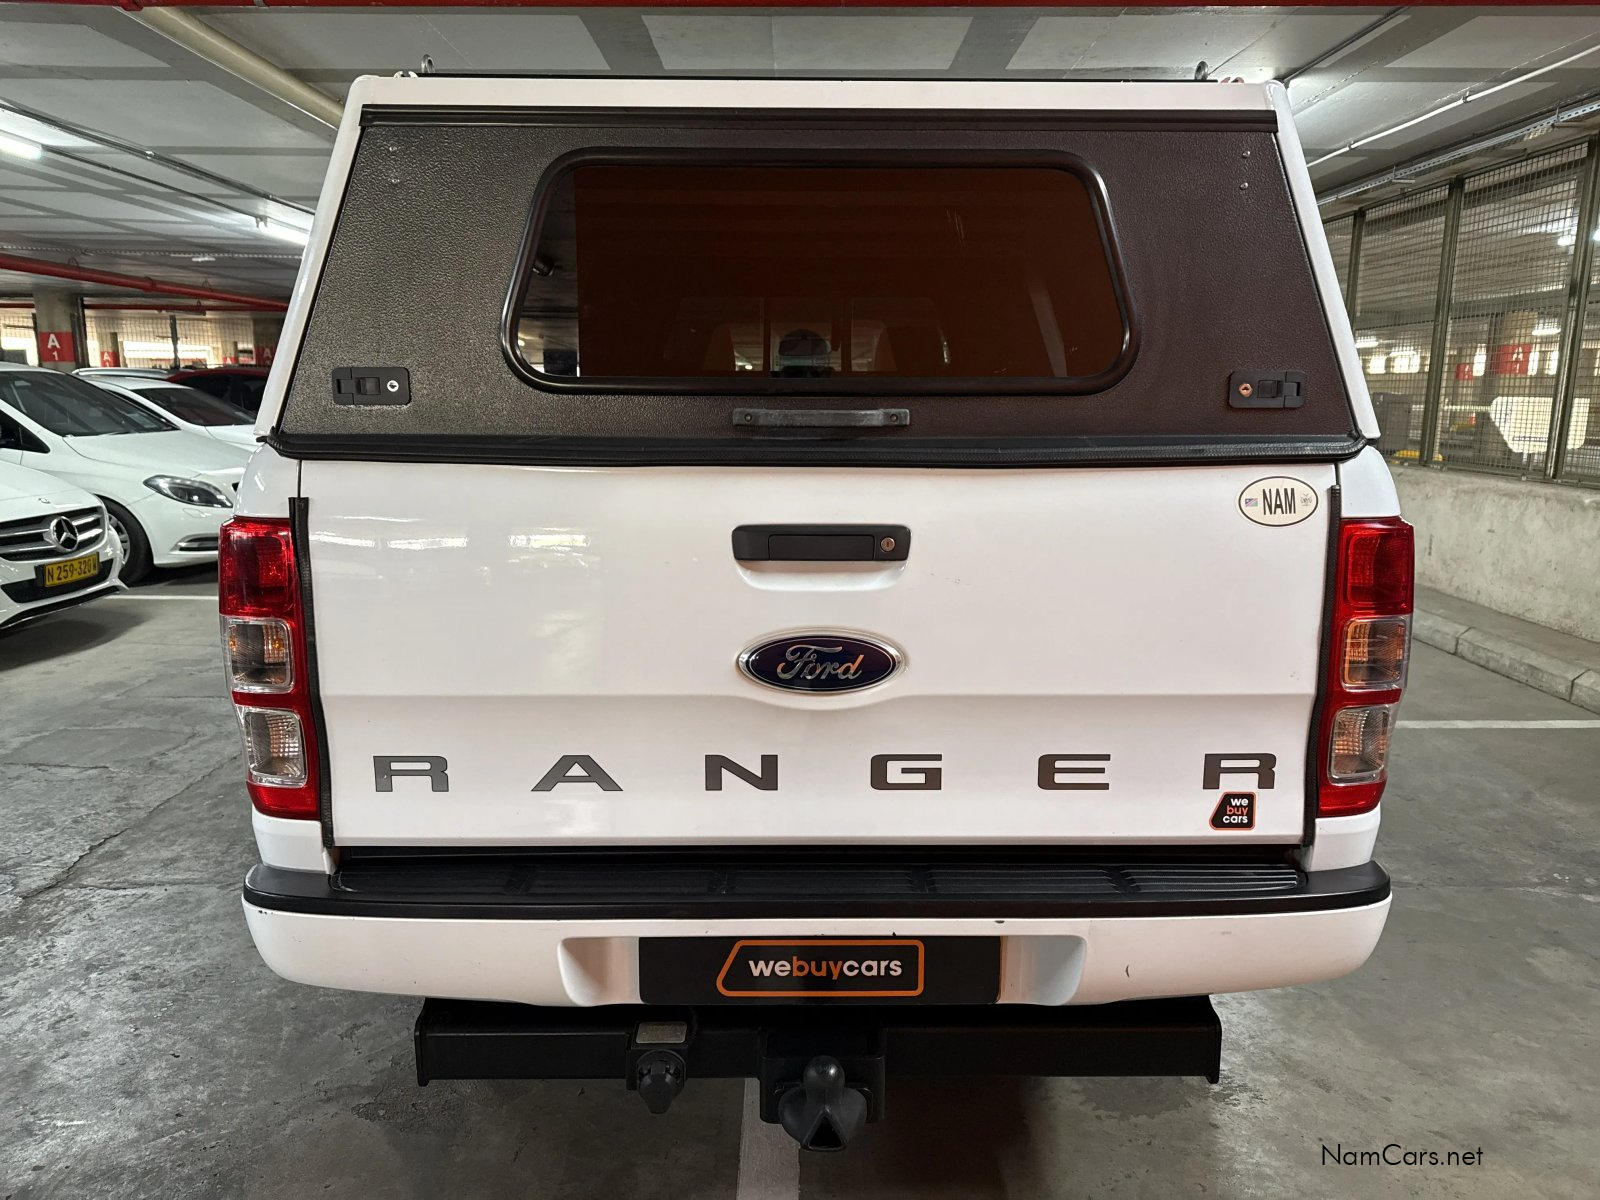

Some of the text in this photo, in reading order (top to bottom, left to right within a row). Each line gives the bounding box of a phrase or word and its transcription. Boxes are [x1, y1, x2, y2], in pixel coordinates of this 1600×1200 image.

[47, 333, 61, 349] A
[52, 351, 59, 361] 1
[103, 351, 111, 361] A
[263, 347, 273, 358] A
[1512, 345, 1524, 361] A
[1262, 487, 1297, 515] NAM
[47, 566, 54, 583] N
[776, 644, 865, 680] Ford
[373, 753, 1277, 792] RANGER
[1226, 804, 1248, 816] buy
[1230, 798, 1249, 806] we
[1222, 815, 1248, 824] cars
[748, 955, 903, 980] webuycars
